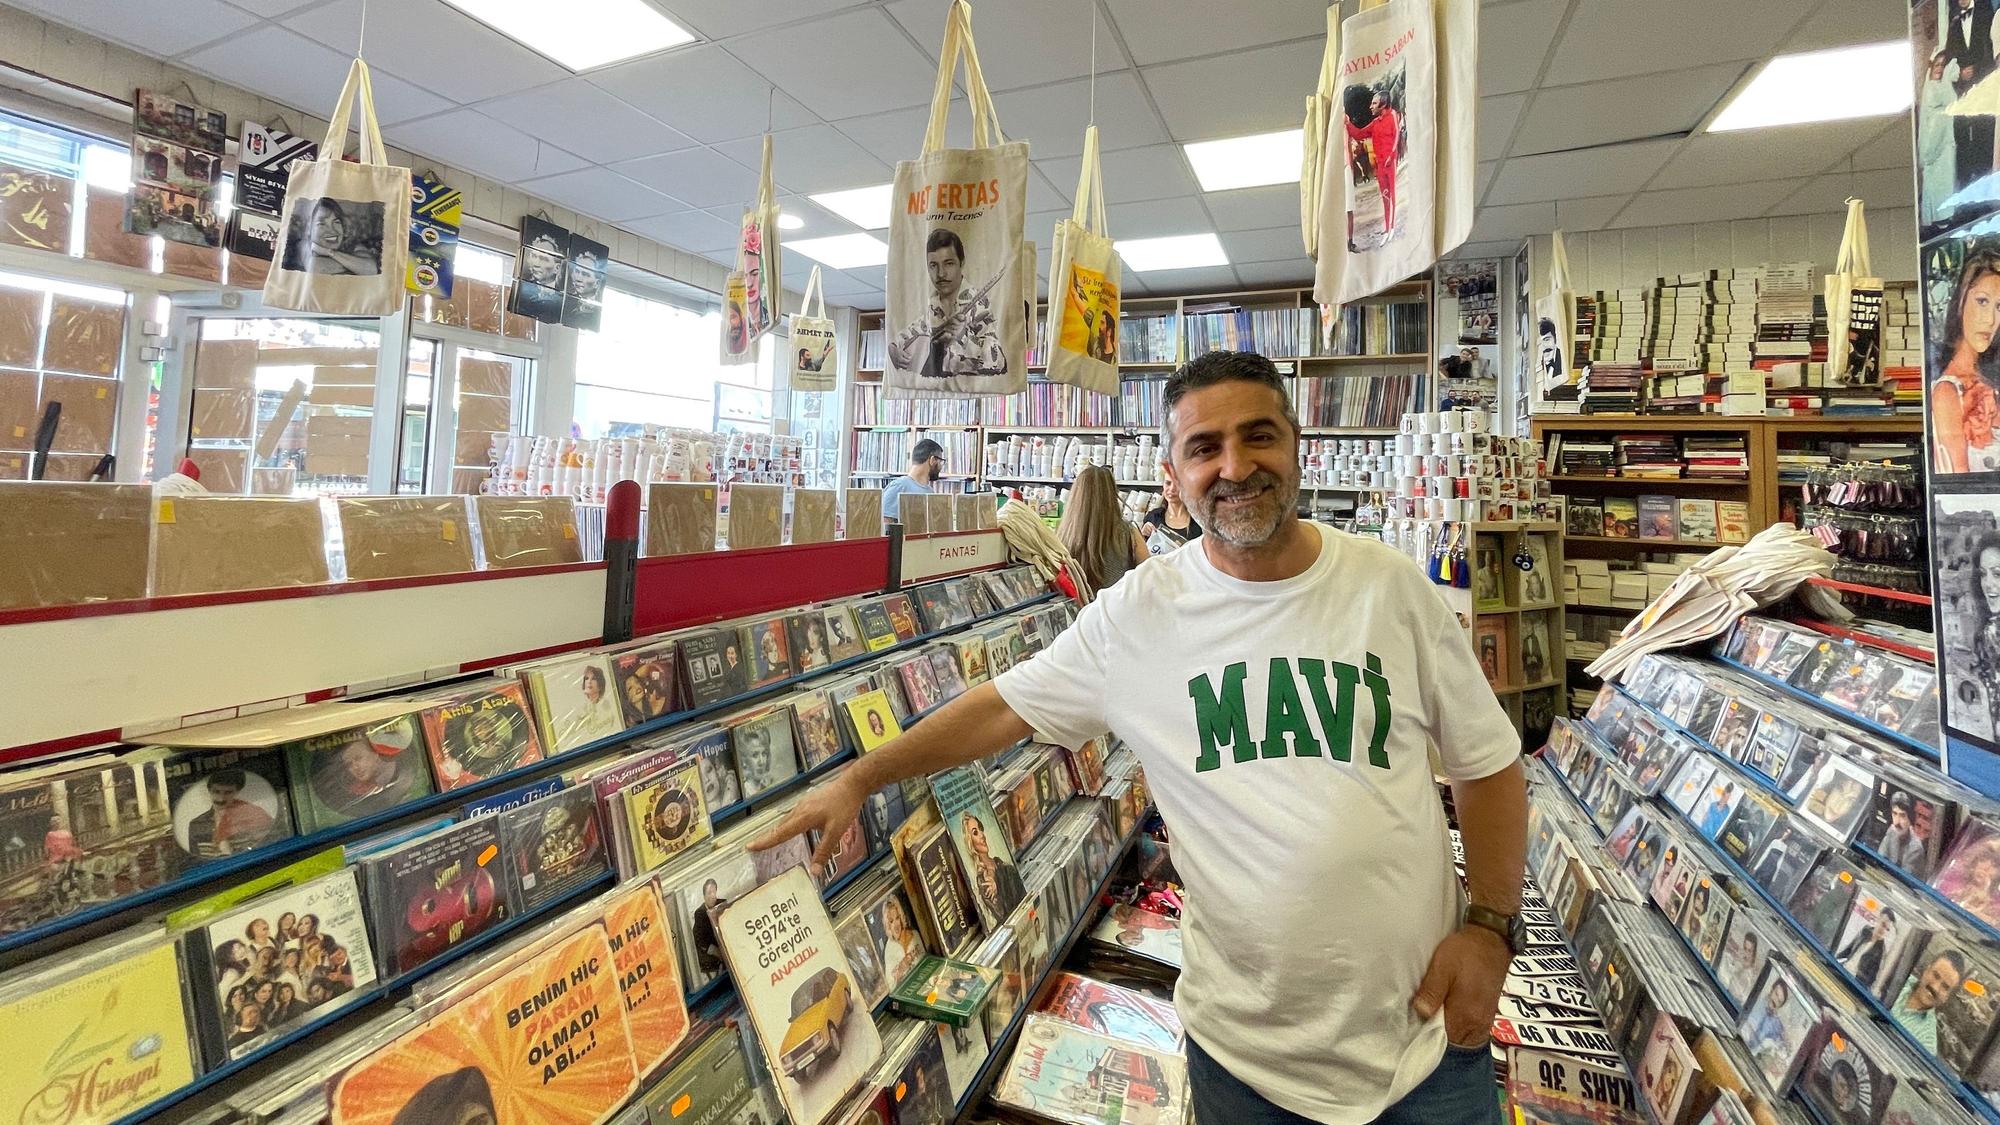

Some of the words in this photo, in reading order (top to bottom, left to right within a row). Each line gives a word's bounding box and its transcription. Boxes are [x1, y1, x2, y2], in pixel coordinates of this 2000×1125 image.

[1344, 52, 1380, 76] AYIM
[1384, 27, 1415, 64] ŞABAN
[937, 178, 1000, 210] ERTAŞ
[939, 542, 980, 560] FANTASİ
[1188, 651, 1391, 773] MAVİ
[626, 916, 650, 942] HİÇ
[744, 914, 771, 937] Sen
[770, 893, 799, 920] Beni
[755, 912, 802, 950] 1974'te
[758, 925, 813, 970] Göreydin
[770, 946, 819, 987] ANADOL
[506, 976, 569, 1030] BENİM
[571, 956, 600, 987] HİÇ
[1523, 980, 1550, 999] 73
[524, 985, 594, 1042] PARAM
[1518, 1024, 1544, 1044] 46
[527, 1005, 600, 1067] OLMADI
[1578, 1068, 1637, 1111] KARS
